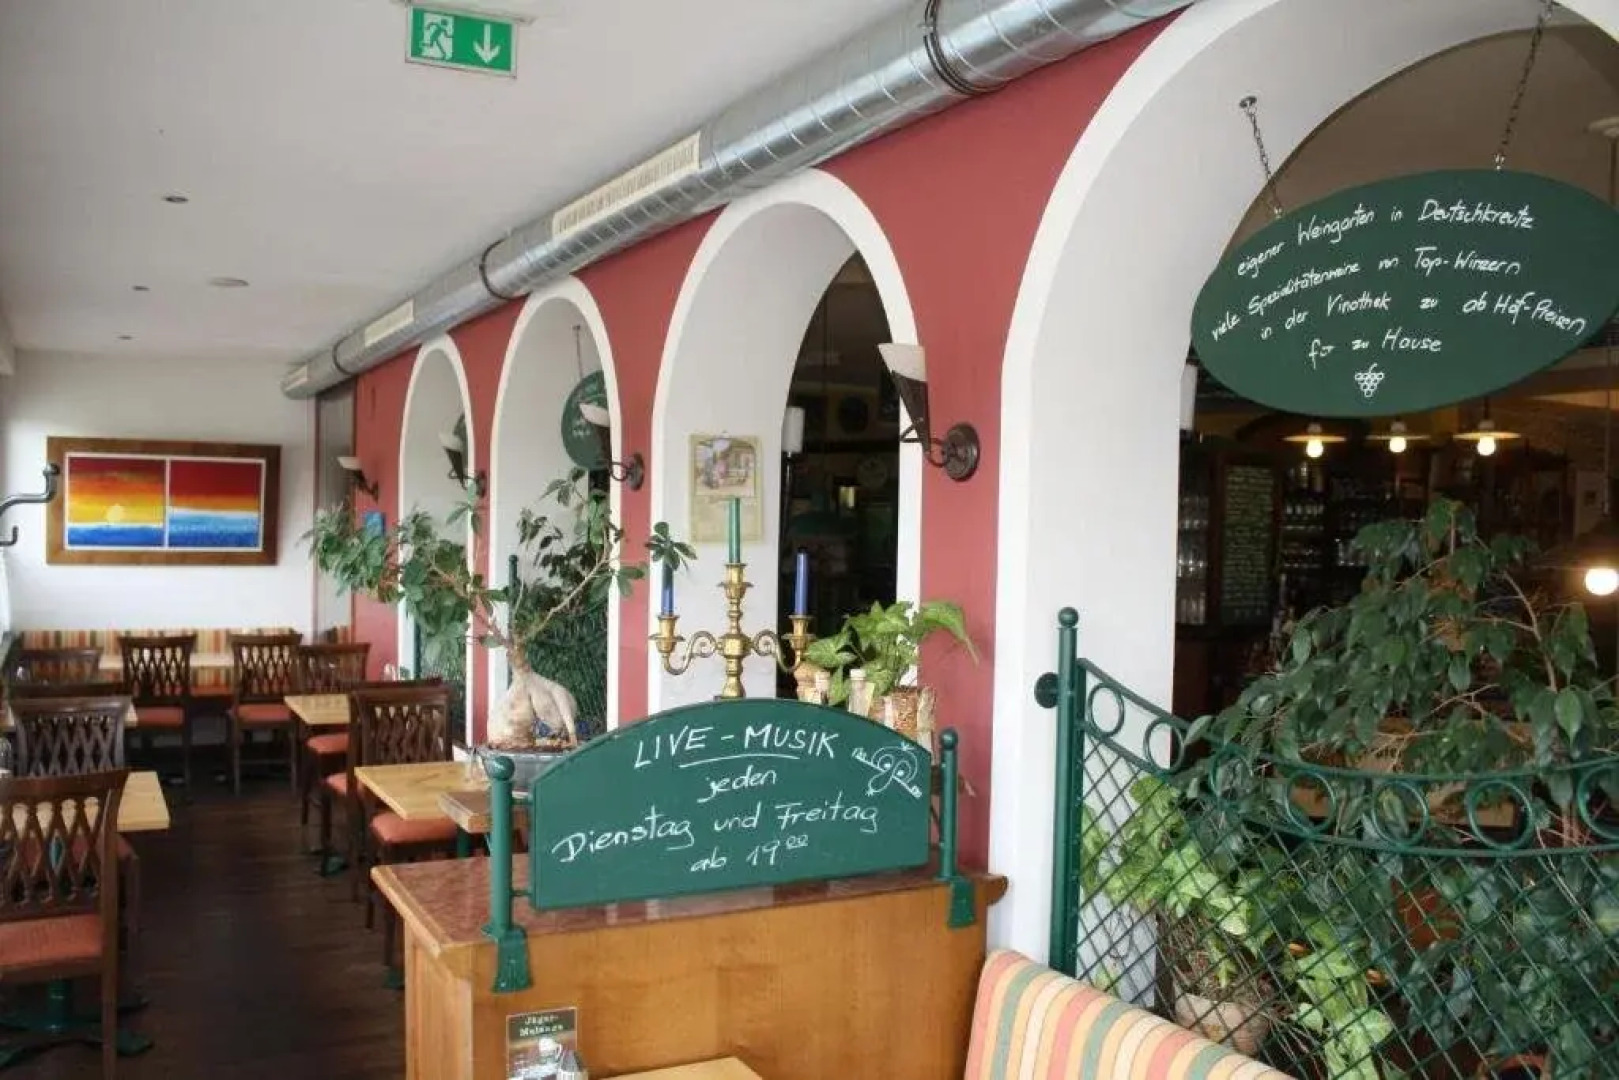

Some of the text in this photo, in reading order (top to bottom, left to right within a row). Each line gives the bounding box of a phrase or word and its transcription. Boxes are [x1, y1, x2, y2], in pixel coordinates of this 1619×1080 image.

[1297, 203, 1375, 246] Weingarten
[1390, 206, 1403, 222] in
[1260, 325, 1274, 340] in
[1284, 308, 1309, 331] der
[1326, 291, 1392, 317] Vinothek
[1419, 296, 1438, 310] zu
[1462, 291, 1486, 314] ab
[1351, 338, 1370, 351] zu
[1381, 327, 1442, 353] Hause
[633, 725, 714, 769] LIVE
[743, 723, 840, 759] MUSIK
[696, 765, 777, 803] jeden
[550, 791, 879, 863] Dienstag und Freitag
[690, 848, 728, 873] ab
